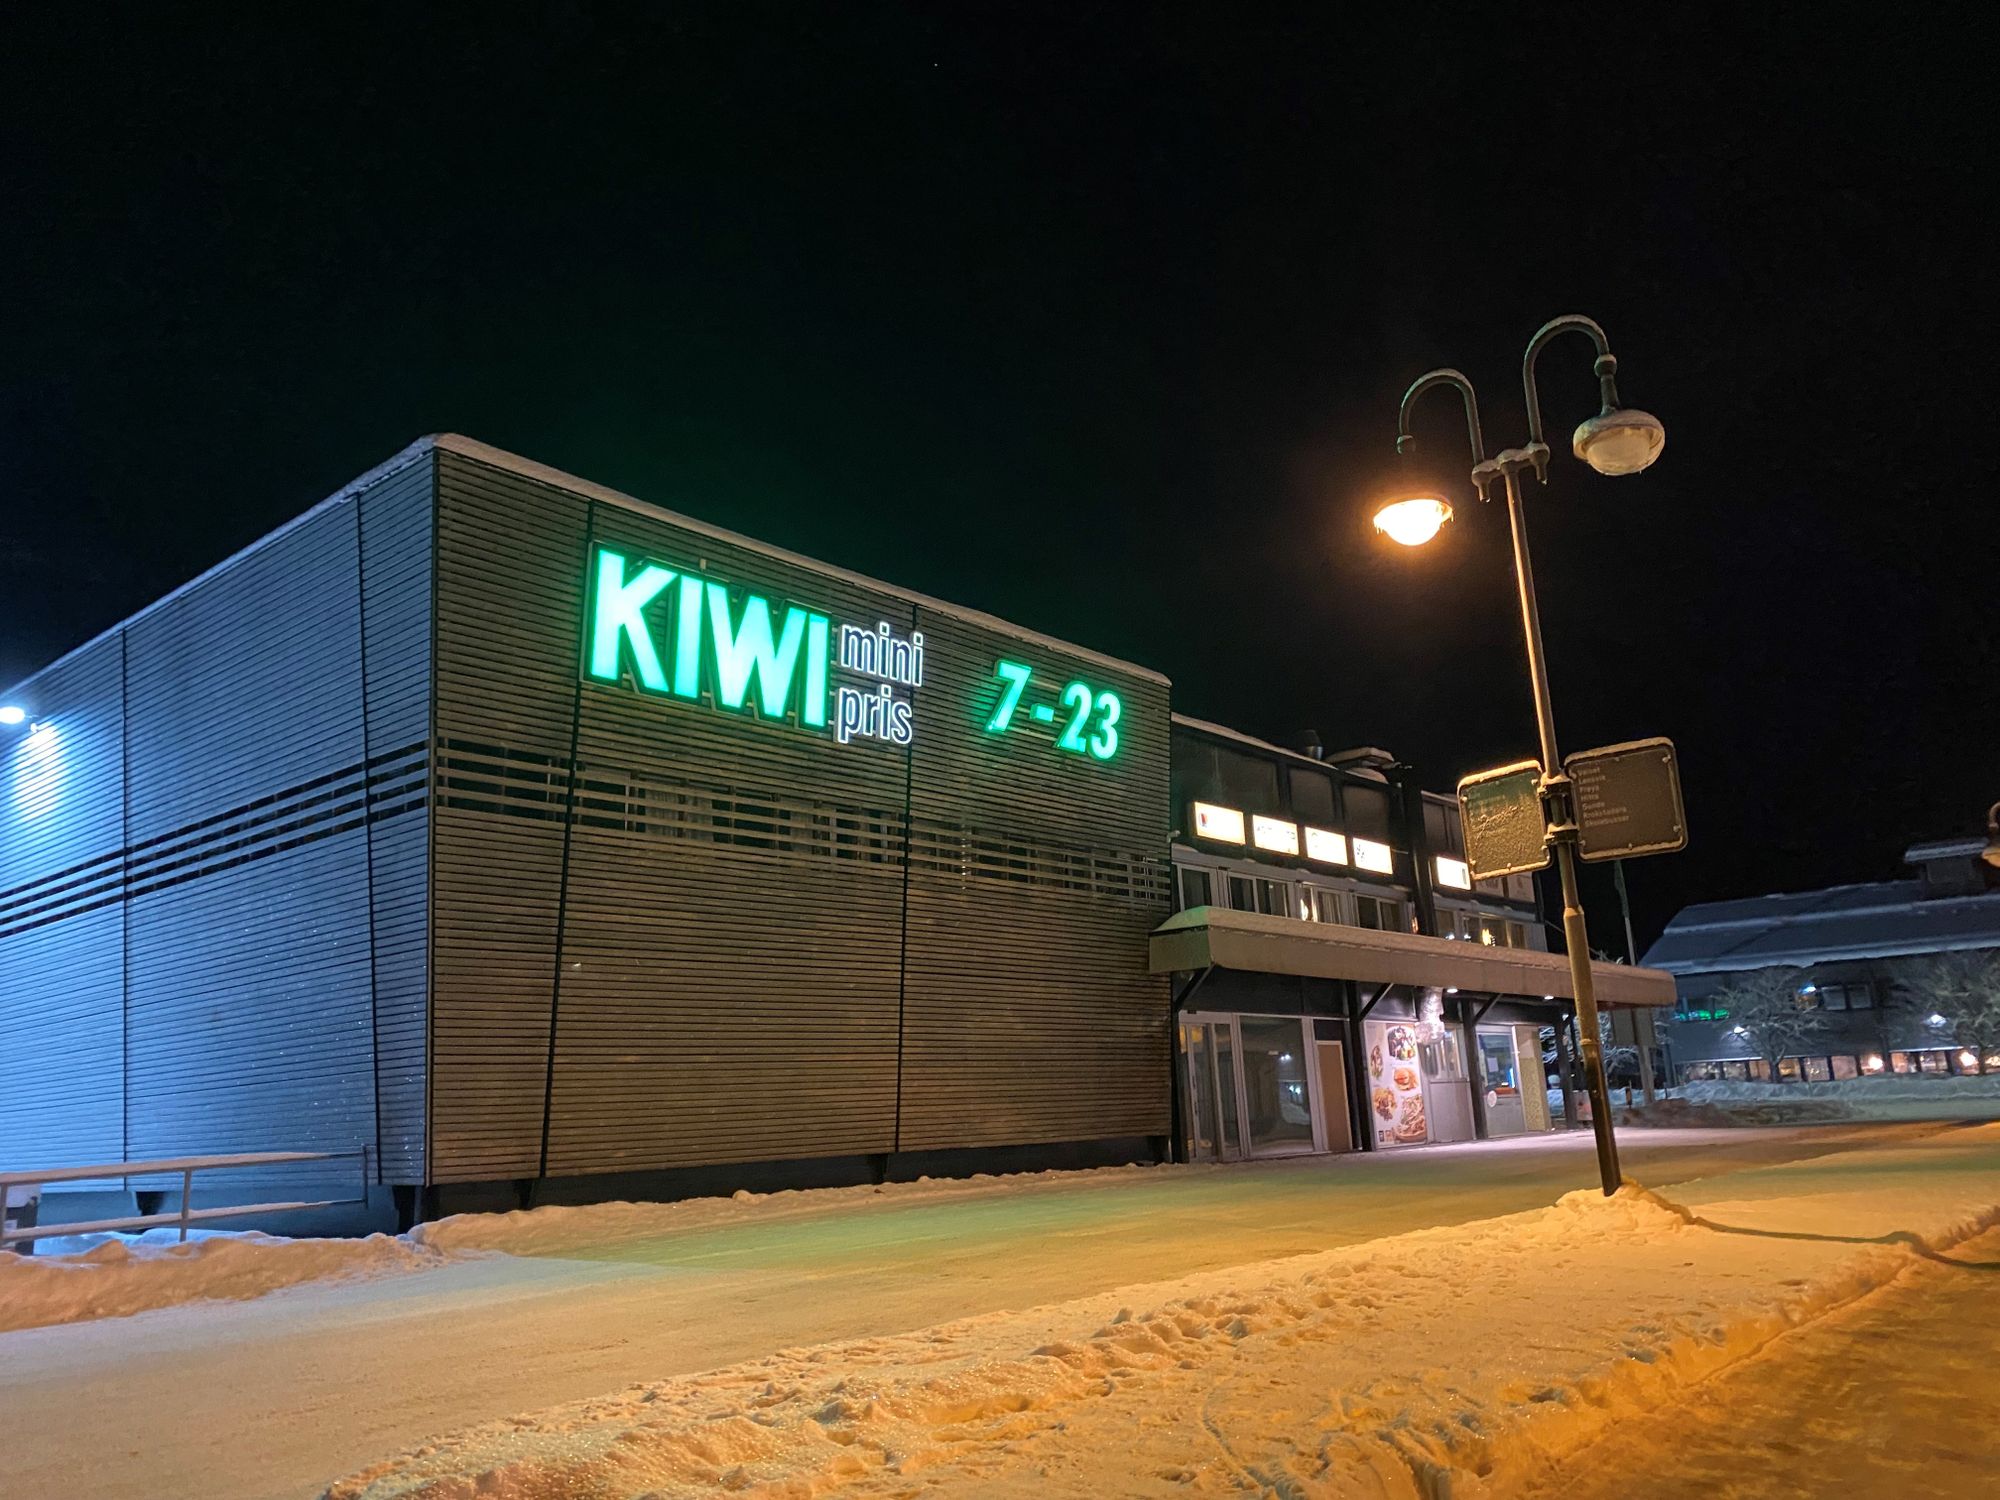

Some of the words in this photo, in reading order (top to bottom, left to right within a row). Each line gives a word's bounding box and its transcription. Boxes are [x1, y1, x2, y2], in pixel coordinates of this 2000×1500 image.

[590, 549, 830, 728] KIWI
[841, 621, 924, 687] mini
[838, 684, 913, 744] pris
